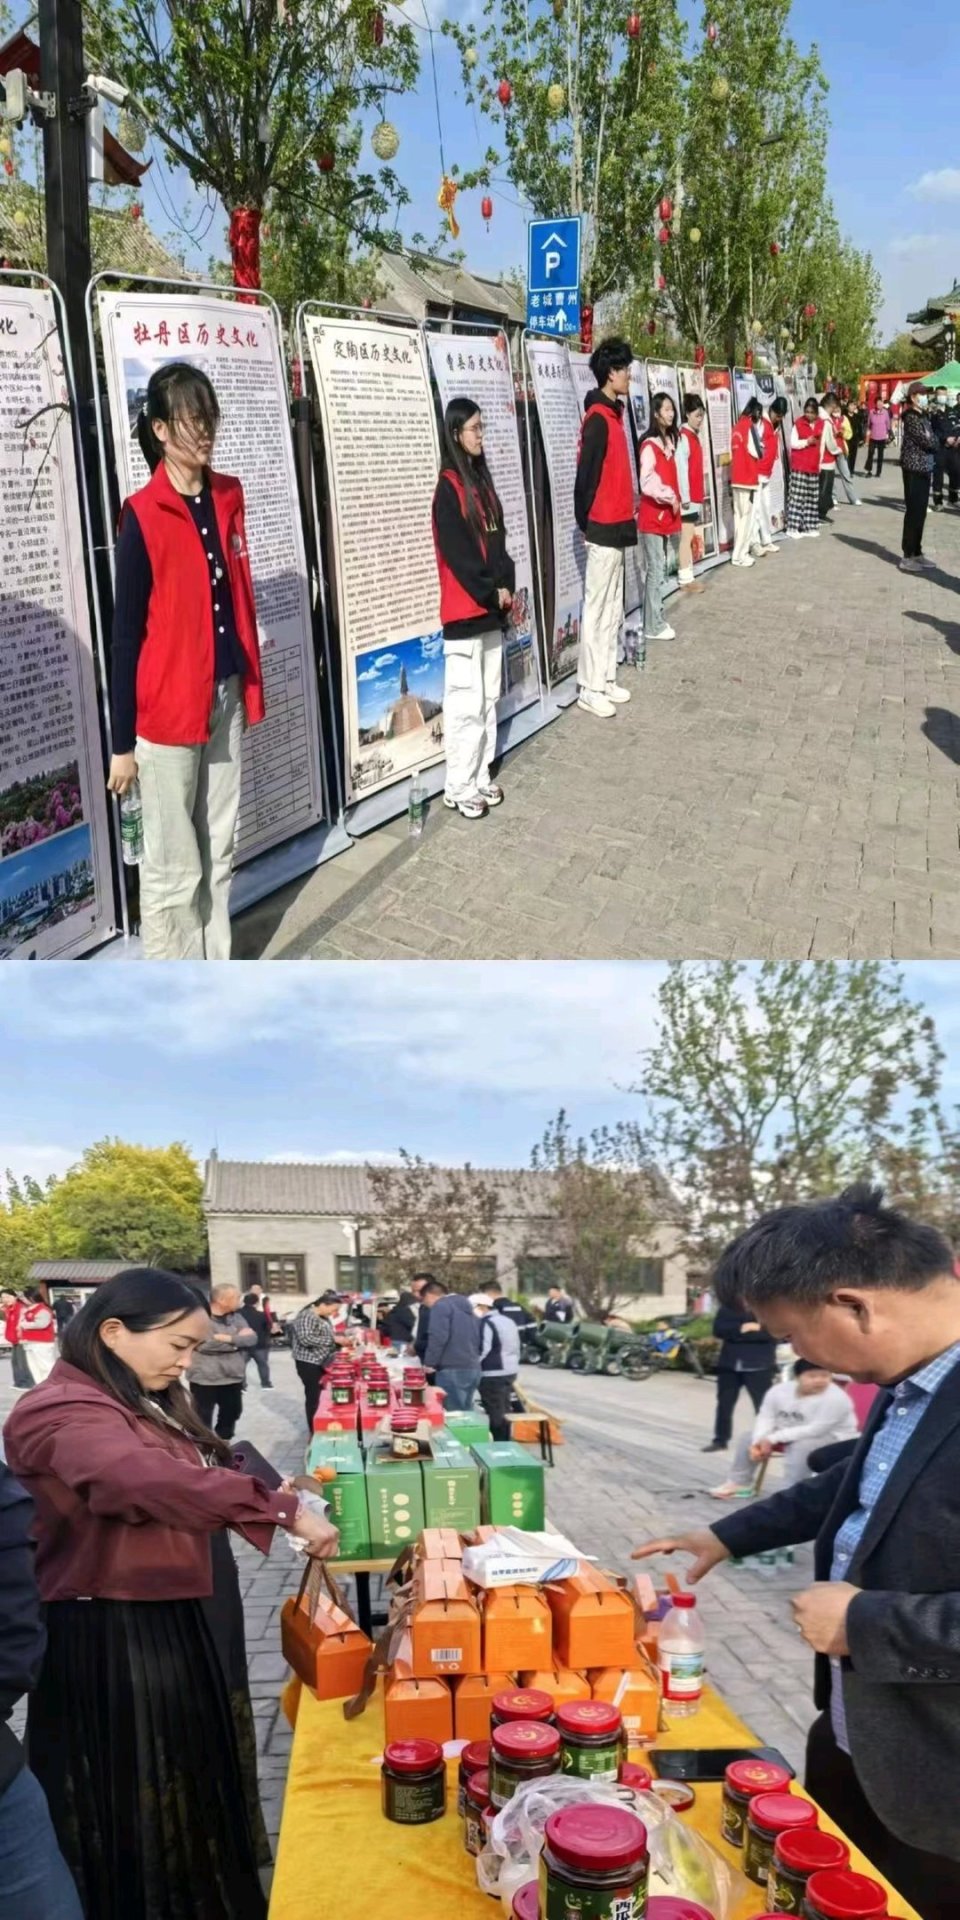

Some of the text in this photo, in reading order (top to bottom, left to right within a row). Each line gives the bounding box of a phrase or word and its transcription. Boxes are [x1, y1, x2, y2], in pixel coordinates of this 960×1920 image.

[545, 251, 561, 279] P
[530, 291, 577, 308] 老城曹州
[529, 314, 556, 330] 停车场
[133, 320, 259, 348] 牡丹区历史文化
[333, 339, 413, 364] 定陶区历史文化
[446, 351, 504, 373] 曹县历史文化
